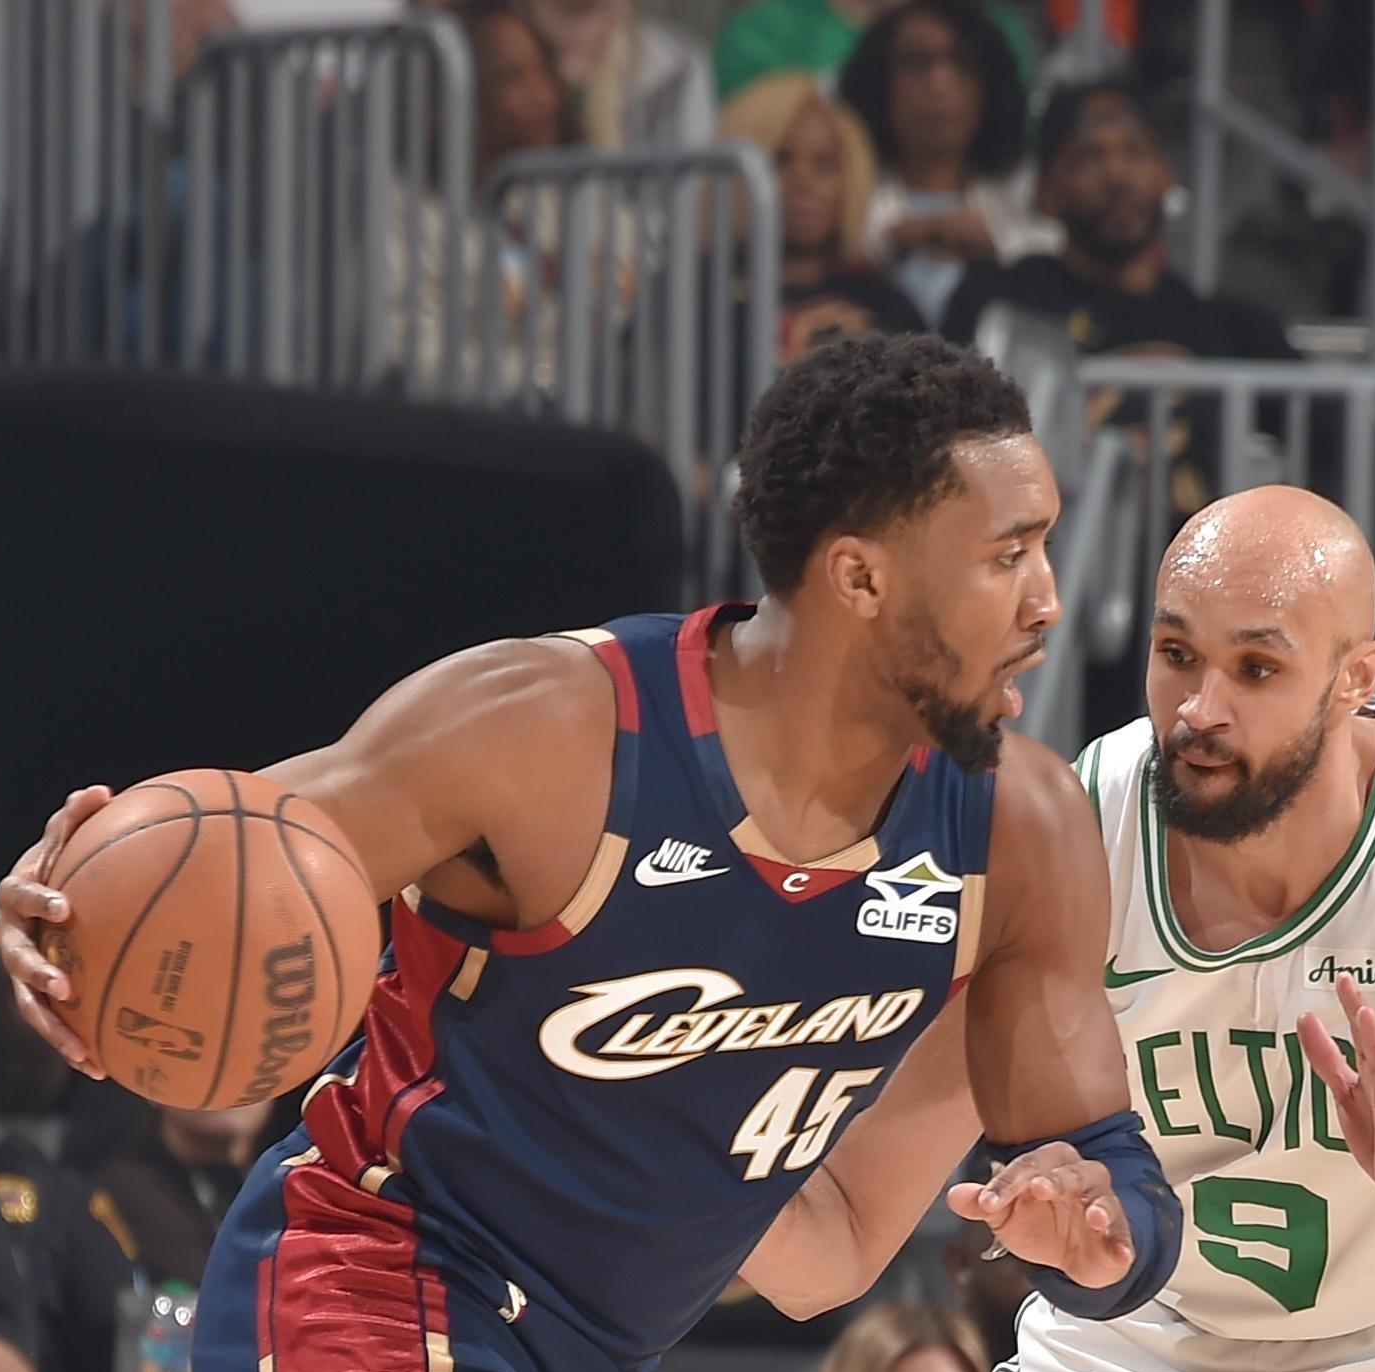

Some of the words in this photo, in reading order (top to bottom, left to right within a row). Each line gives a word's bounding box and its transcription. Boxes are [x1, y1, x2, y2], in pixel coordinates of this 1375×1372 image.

[652, 837, 713, 874] NIKE
[862, 907, 954, 936] CLIFFS
[729, 1066, 885, 1182] 45
[1191, 1175, 1329, 1313] 9
